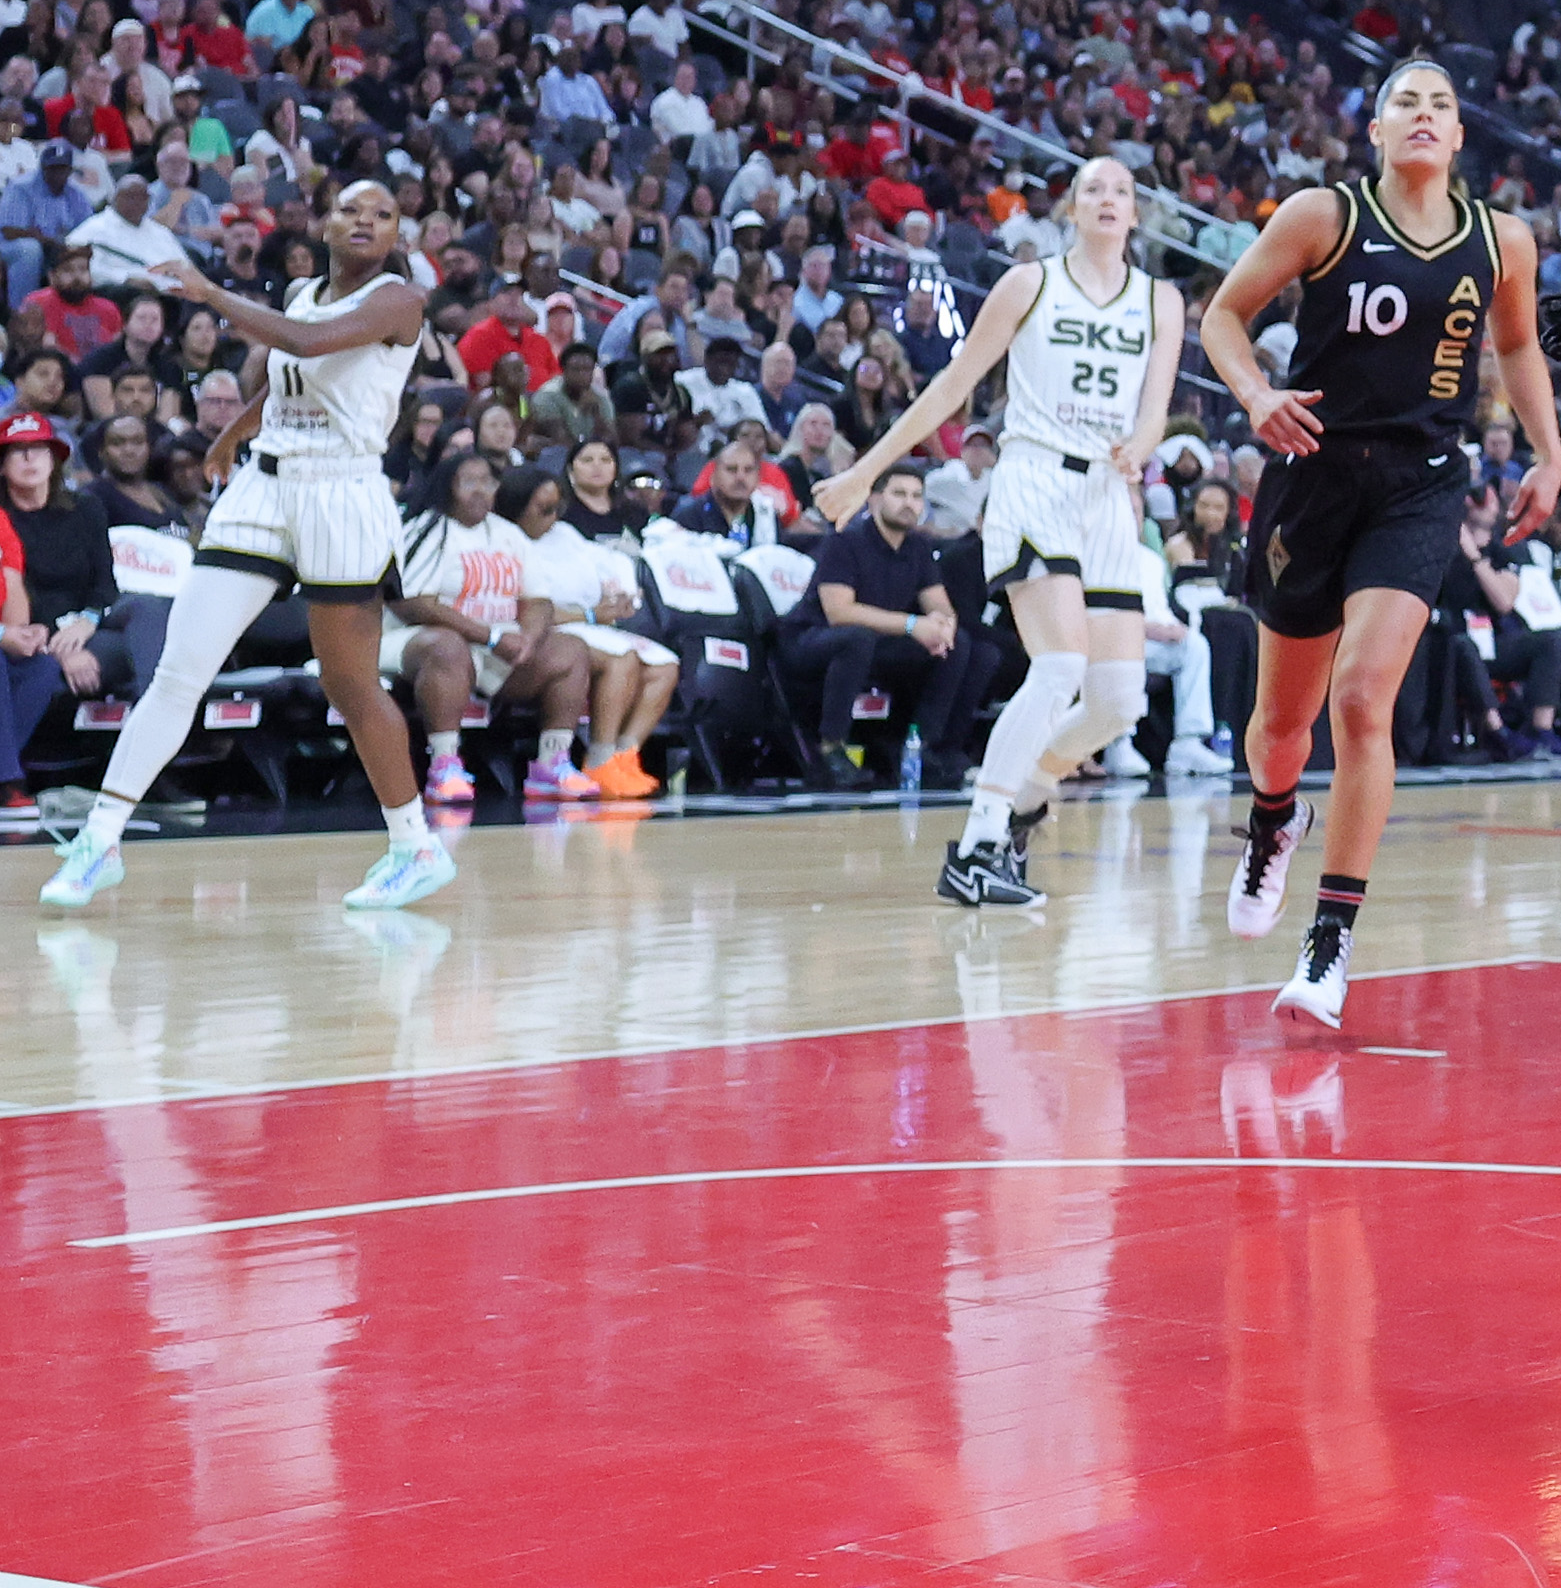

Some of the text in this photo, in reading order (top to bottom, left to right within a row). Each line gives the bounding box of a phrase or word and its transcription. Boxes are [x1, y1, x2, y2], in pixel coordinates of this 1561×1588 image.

[1346, 280, 1409, 336] 10
[1048, 318, 1145, 356] SKY
[1428, 274, 1481, 400] ACES
[282, 362, 304, 397] 11
[1071, 359, 1119, 399] 25
